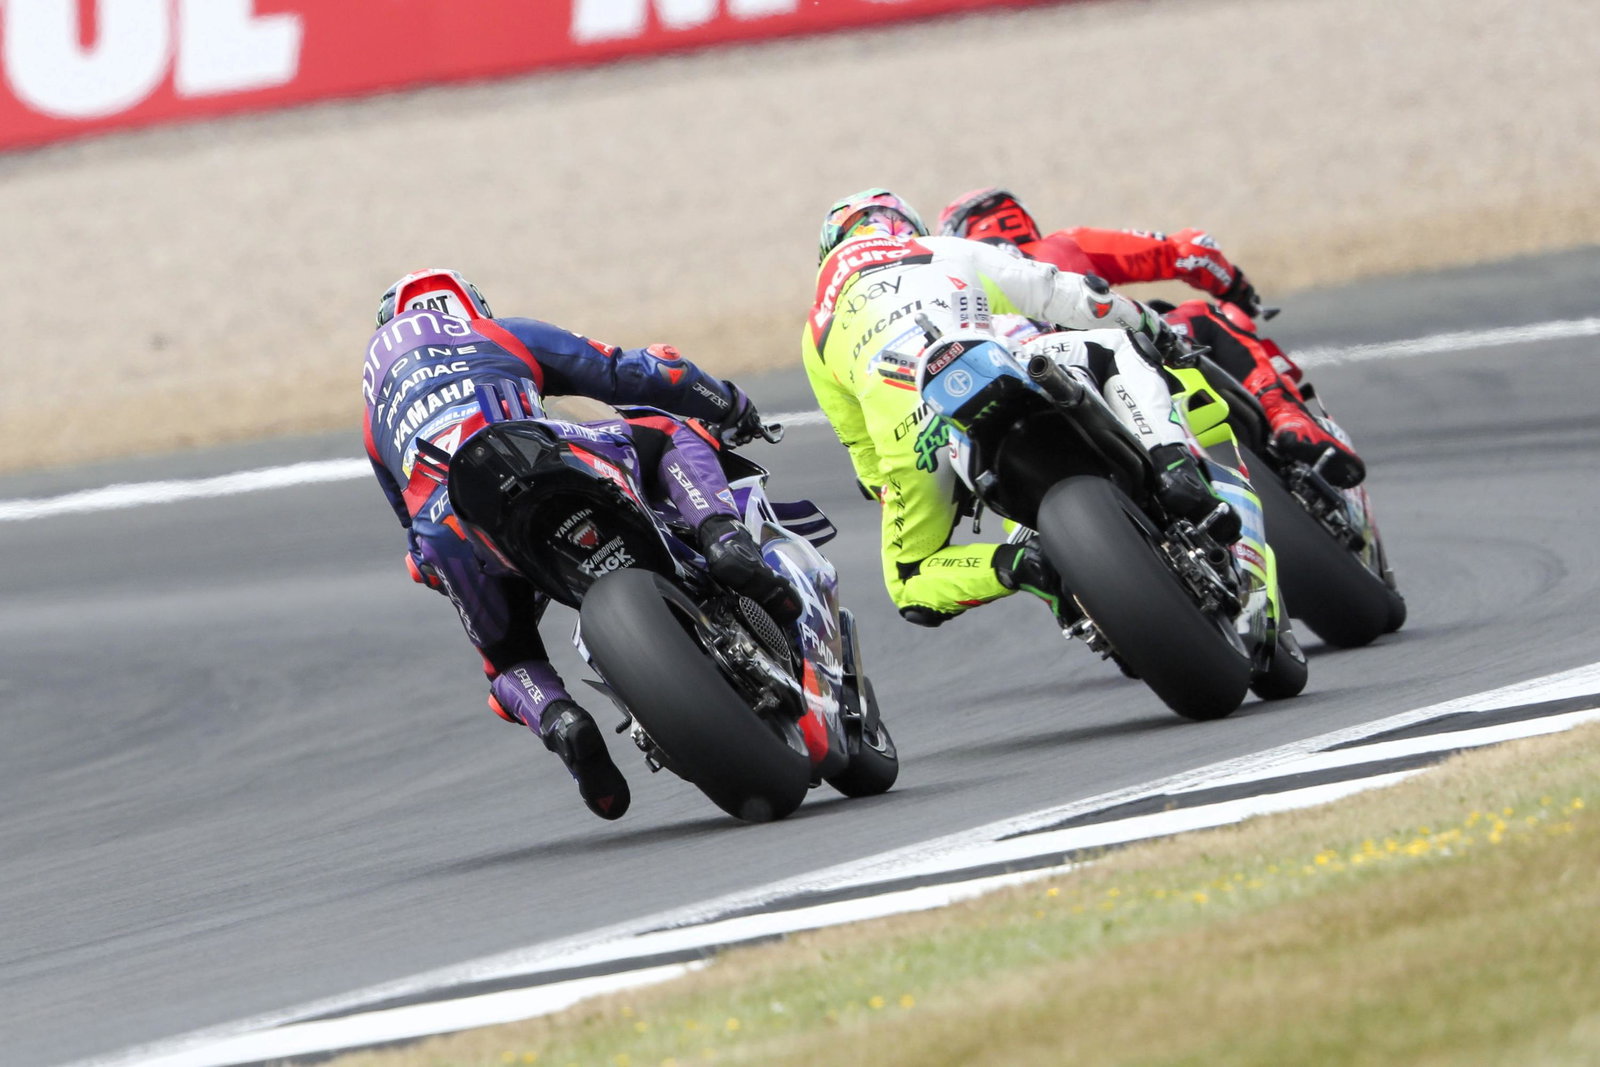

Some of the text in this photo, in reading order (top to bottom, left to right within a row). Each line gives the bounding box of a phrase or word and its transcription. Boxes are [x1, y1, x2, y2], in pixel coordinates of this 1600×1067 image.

[853, 300, 922, 359] DUCATI
[377, 345, 477, 423] ALPINE
[387, 361, 469, 429] PRAMAC
[692, 382, 729, 410] DAINESE
[1115, 383, 1153, 435] DAINESE
[393, 378, 476, 453] YAMAHA
[667, 461, 711, 510] DAINESE
[554, 508, 593, 539] YAMAHA
[594, 547, 632, 578] NGK
[927, 555, 982, 568] DAINESE
